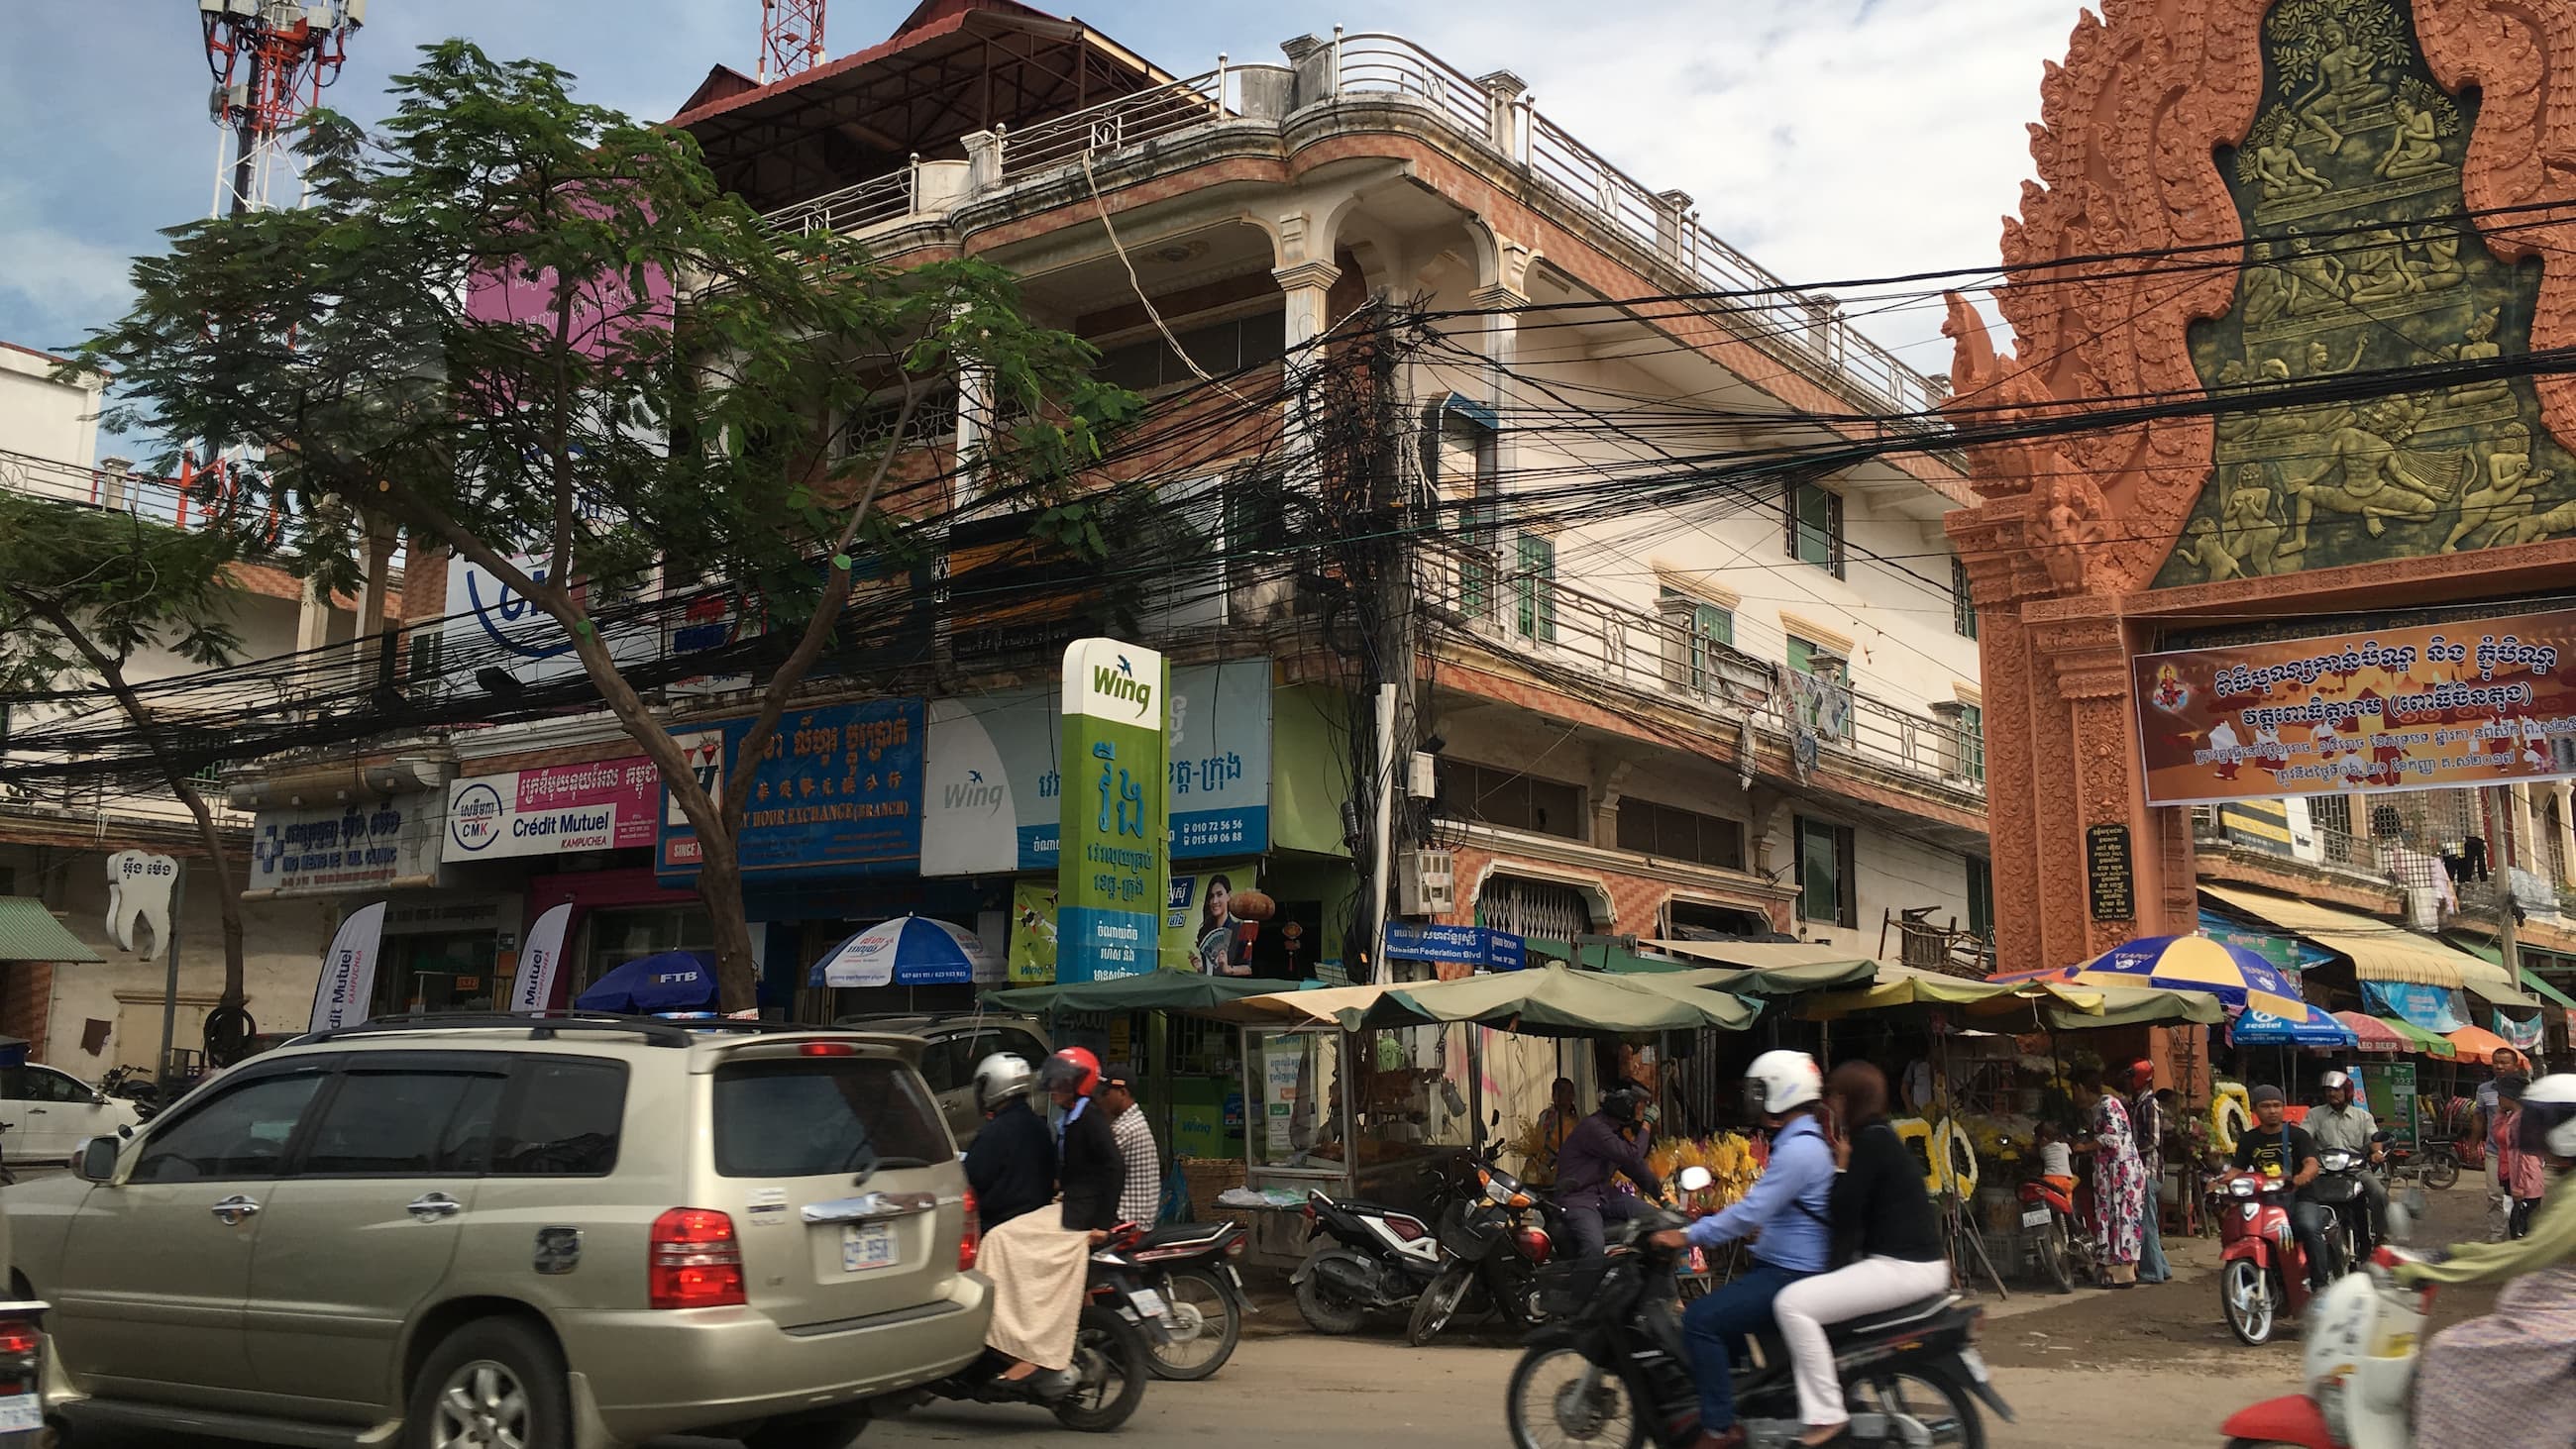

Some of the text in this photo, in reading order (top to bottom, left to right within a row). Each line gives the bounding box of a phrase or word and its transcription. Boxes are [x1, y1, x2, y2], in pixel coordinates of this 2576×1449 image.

[2426, 635, 2465, 662] និង
[1094, 665, 1151, 718] Wing
[944, 783, 1004, 817] Wing
[513, 816, 557, 838] Crédit
[560, 811, 609, 833] Mutuel
[753, 809, 786, 826] HOUR
[462, 822, 487, 837] CMK
[1192, 819, 1243, 832] 010 72 56 56
[561, 835, 606, 849] KAMPUCHEA
[1192, 832, 1242, 845] 015 69 06 88
[674, 843, 696, 857] SINCE
[1387, 944, 1419, 955] Russian
[1419, 948, 1461, 959] Federation
[332, 949, 353, 1003] Mutuel
[348, 950, 363, 1004] KAMPUCHEA
[524, 949, 543, 1005] Mutuel
[660, 972, 698, 983] FTB
[1020, 965, 1043, 979] Wing
[2375, 1041, 2398, 1050] BEER
[1182, 1120, 1211, 1135] Wing
